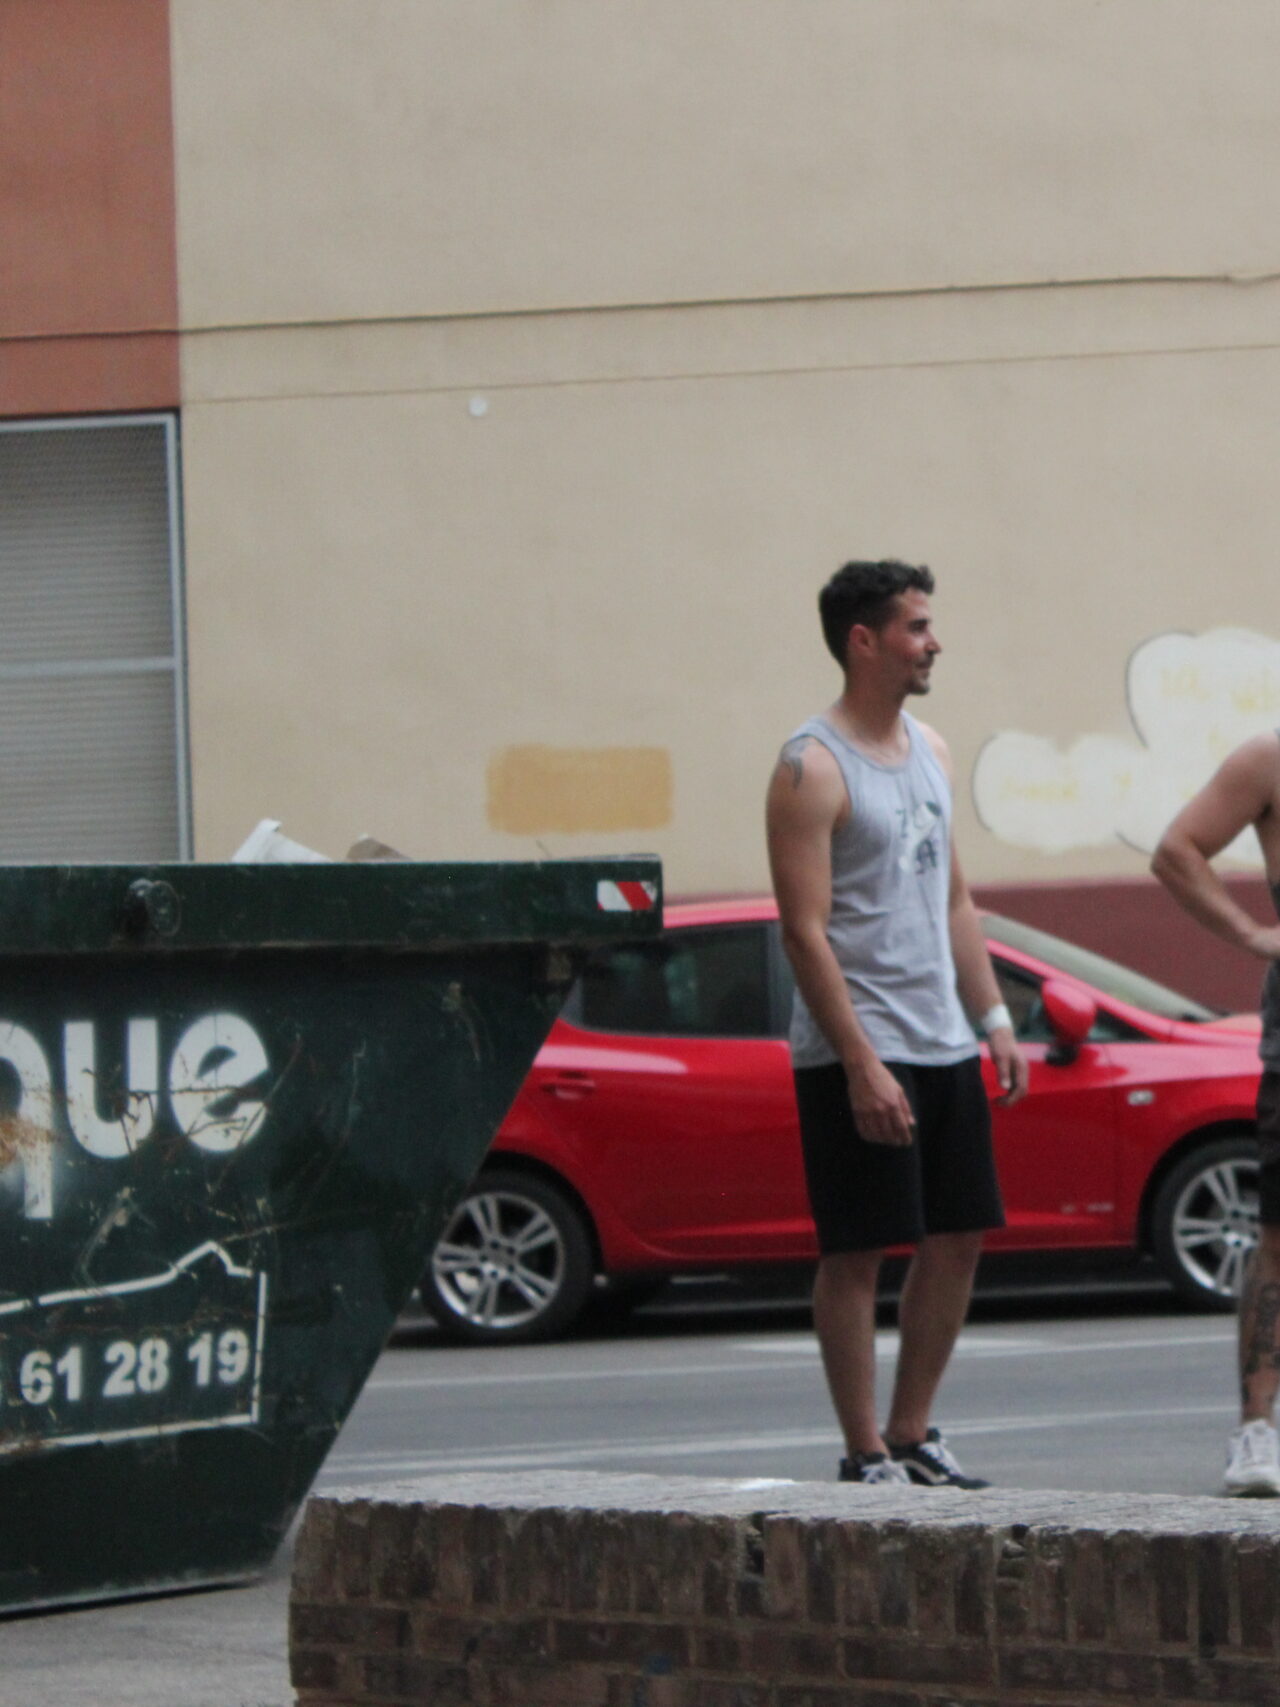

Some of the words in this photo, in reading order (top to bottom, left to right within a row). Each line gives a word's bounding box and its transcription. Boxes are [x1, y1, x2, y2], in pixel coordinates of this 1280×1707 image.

[20, 1346, 83, 1405] 61
[103, 1337, 170, 1398] 28
[187, 1329, 249, 1387] 19
